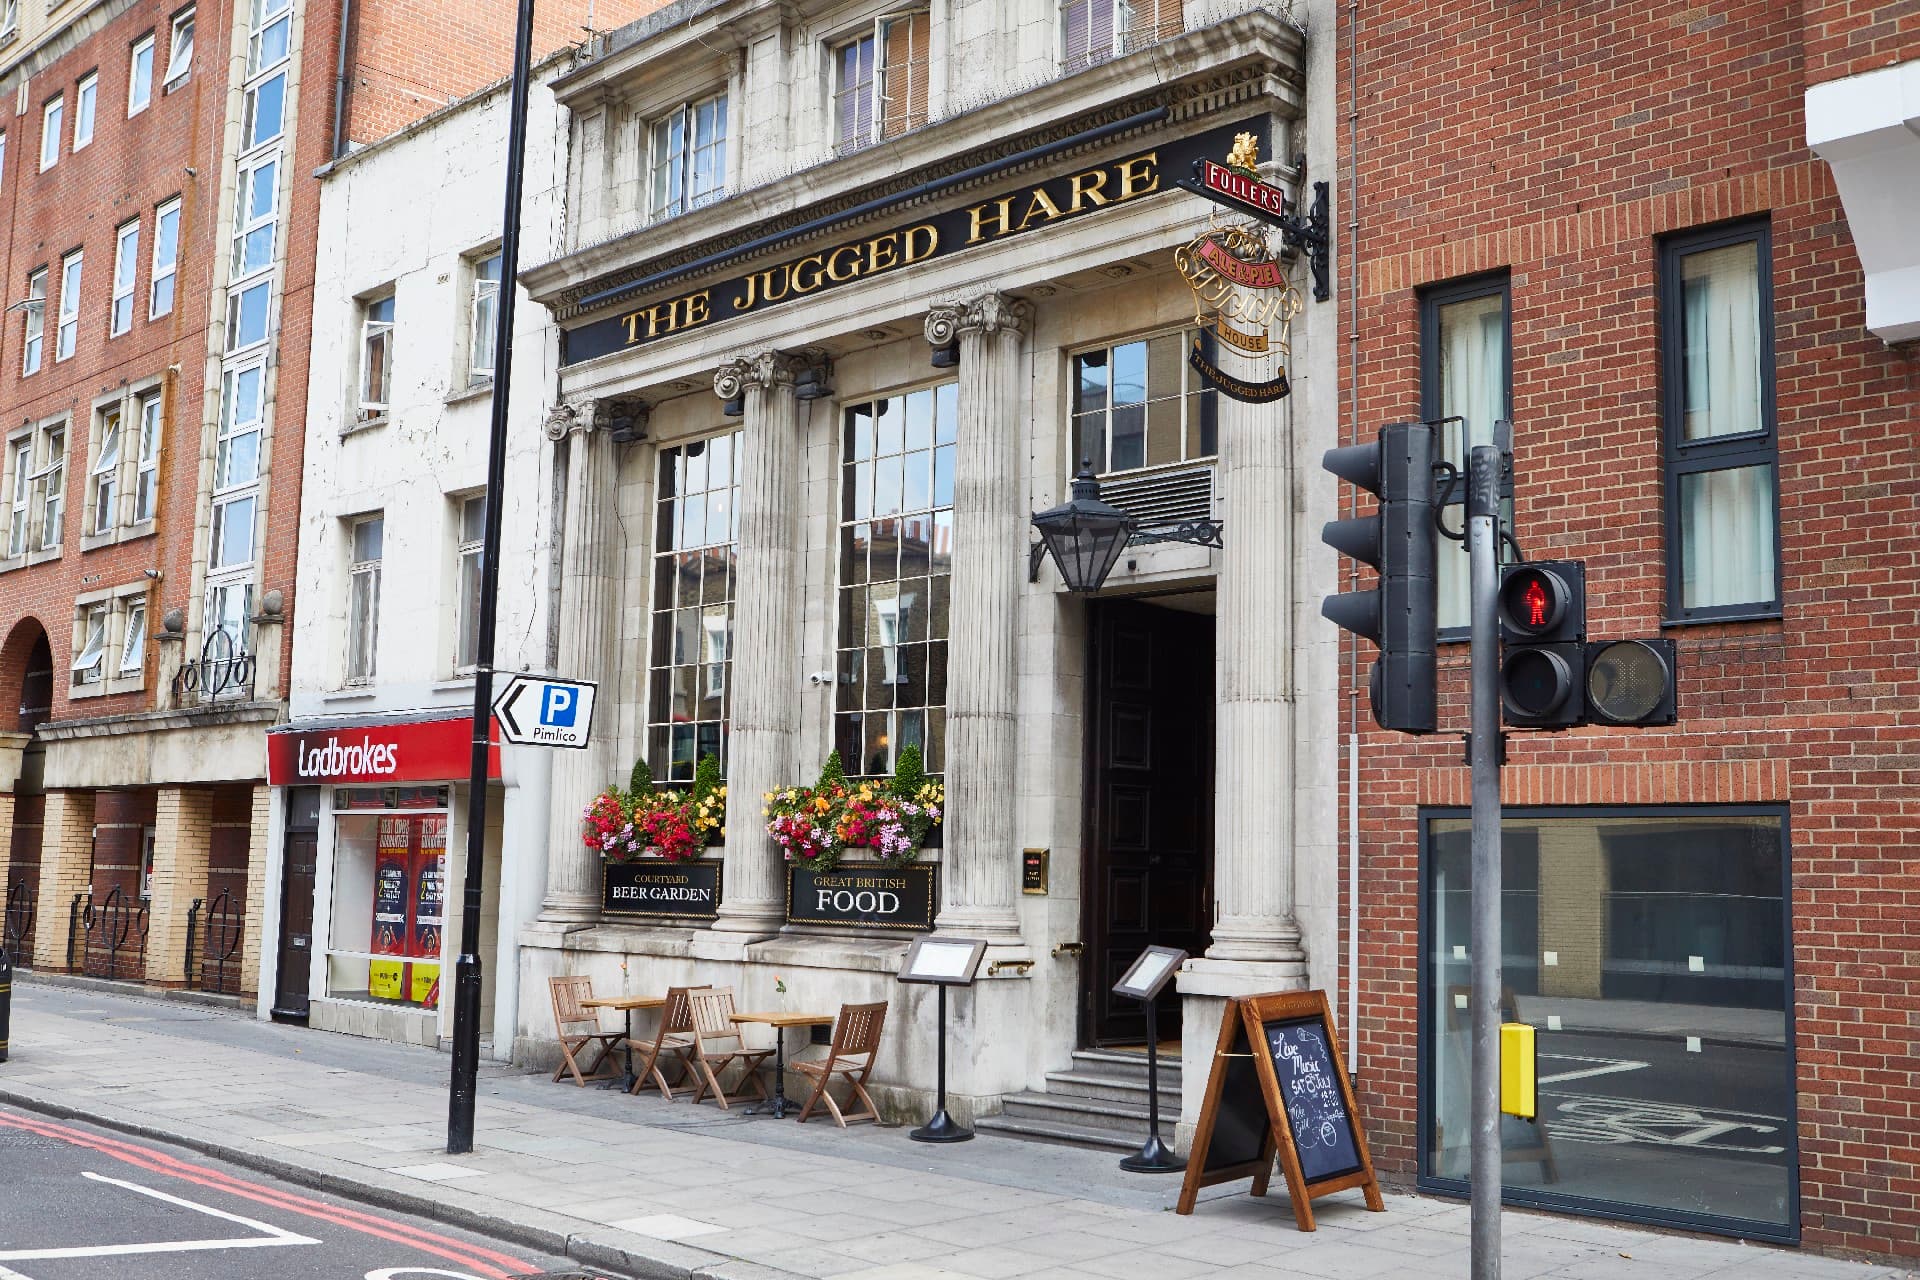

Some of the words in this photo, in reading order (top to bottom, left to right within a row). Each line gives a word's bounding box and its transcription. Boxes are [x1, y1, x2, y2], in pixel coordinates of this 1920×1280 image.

[1210, 165, 1279, 210] FULLER'S
[620, 289, 710, 345] THE
[733, 224, 939, 311] JUGGED
[965, 151, 1161, 245] HARE
[1208, 247, 1237, 278] ALE
[1250, 266, 1274, 284] PIE
[1224, 327, 1262, 349] HOUSE
[1194, 353, 1216, 377] THE
[1215, 375, 1258, 397] JUGGED
[1259, 382, 1287, 397] HARE
[547, 688, 571, 723] P
[533, 727, 577, 743] Pimlico
[298, 735, 398, 777] Ladbrokes
[634, 873, 689, 885] COURTYARD
[813, 876, 855, 888] GREAT
[856, 877, 907, 889] BRITISH
[612, 886, 648, 900] BEER
[650, 887, 711, 902] GARDEN
[815, 889, 901, 914] FOOD
[1273, 1032, 1299, 1060] Live
[1292, 1054, 1321, 1076] Music
